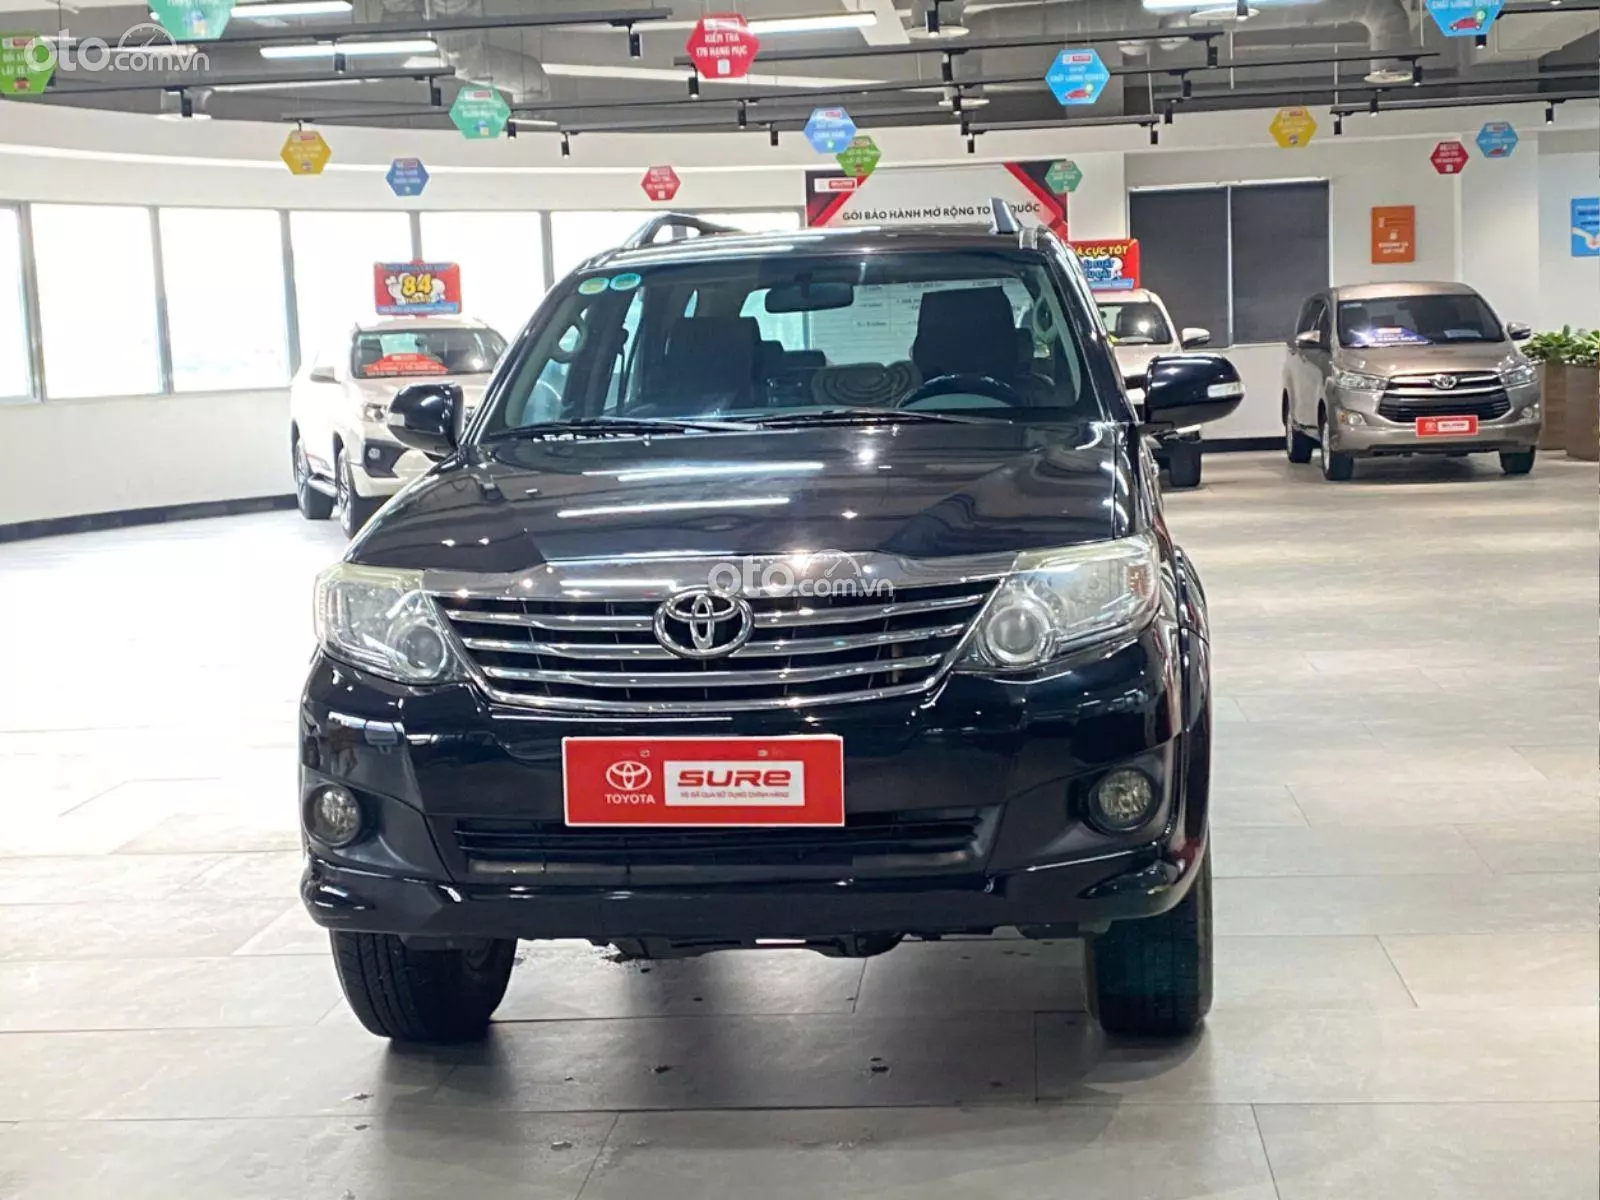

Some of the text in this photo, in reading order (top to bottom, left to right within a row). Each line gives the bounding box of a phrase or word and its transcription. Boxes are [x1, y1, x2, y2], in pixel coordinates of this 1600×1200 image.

[842, 209, 862, 221] GÓI
[865, 208, 887, 220] BẢO
[889, 206, 921, 218] HÀNH
[923, 205, 941, 217] MỞ
[943, 205, 974, 219] RỘNG
[1108, 243, 1128, 255] TỐT
[402, 272, 432, 297] 84
[605, 794, 656, 805] TOYOTA
